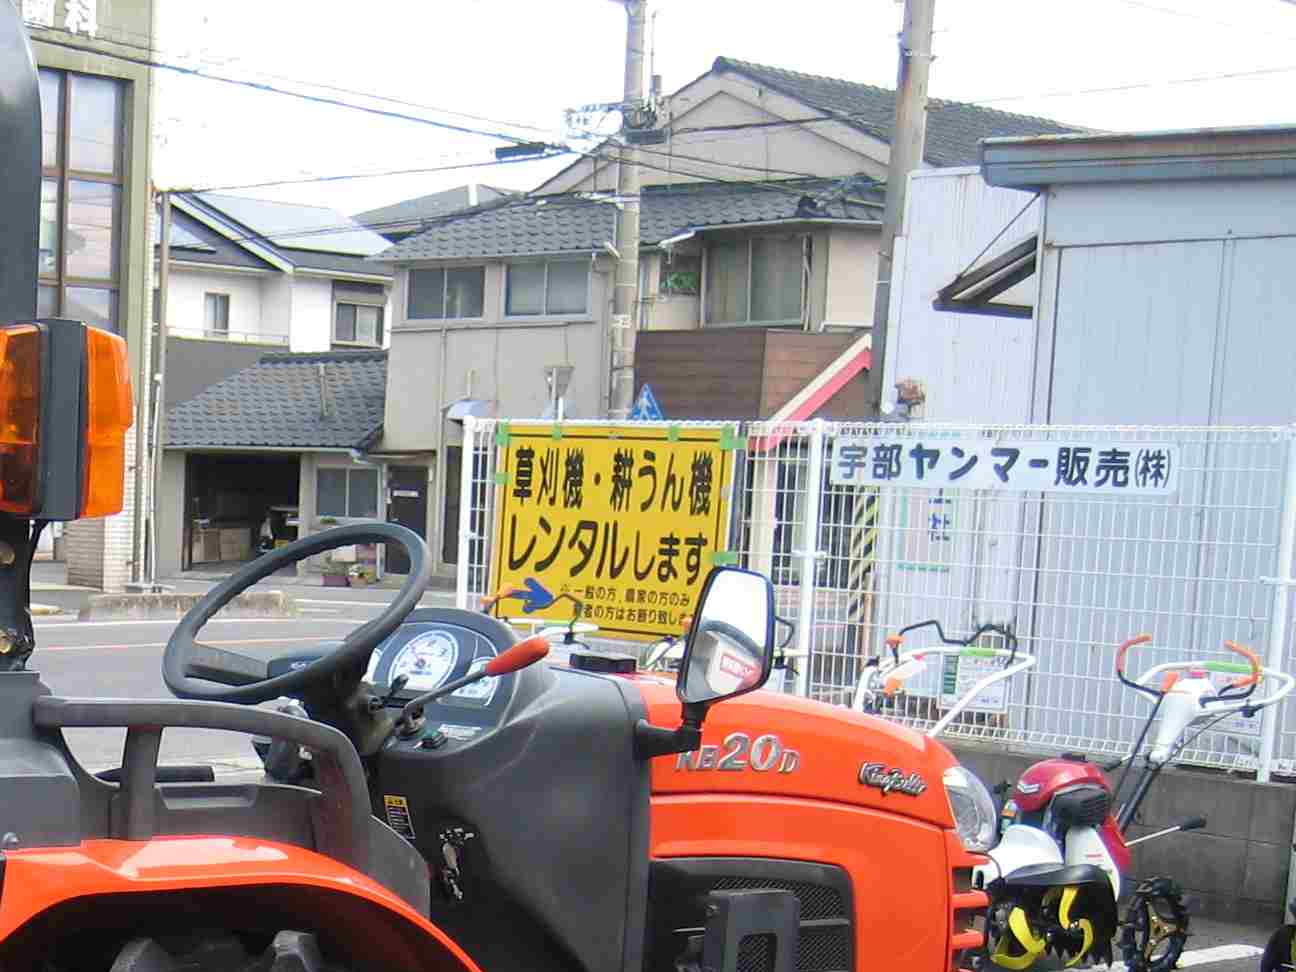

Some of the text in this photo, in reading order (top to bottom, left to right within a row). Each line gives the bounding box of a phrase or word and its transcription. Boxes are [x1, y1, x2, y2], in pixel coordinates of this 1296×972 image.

[512, 445, 713, 517] 草刈機・耕うん機
[508, 513, 708, 586] レンタルします
